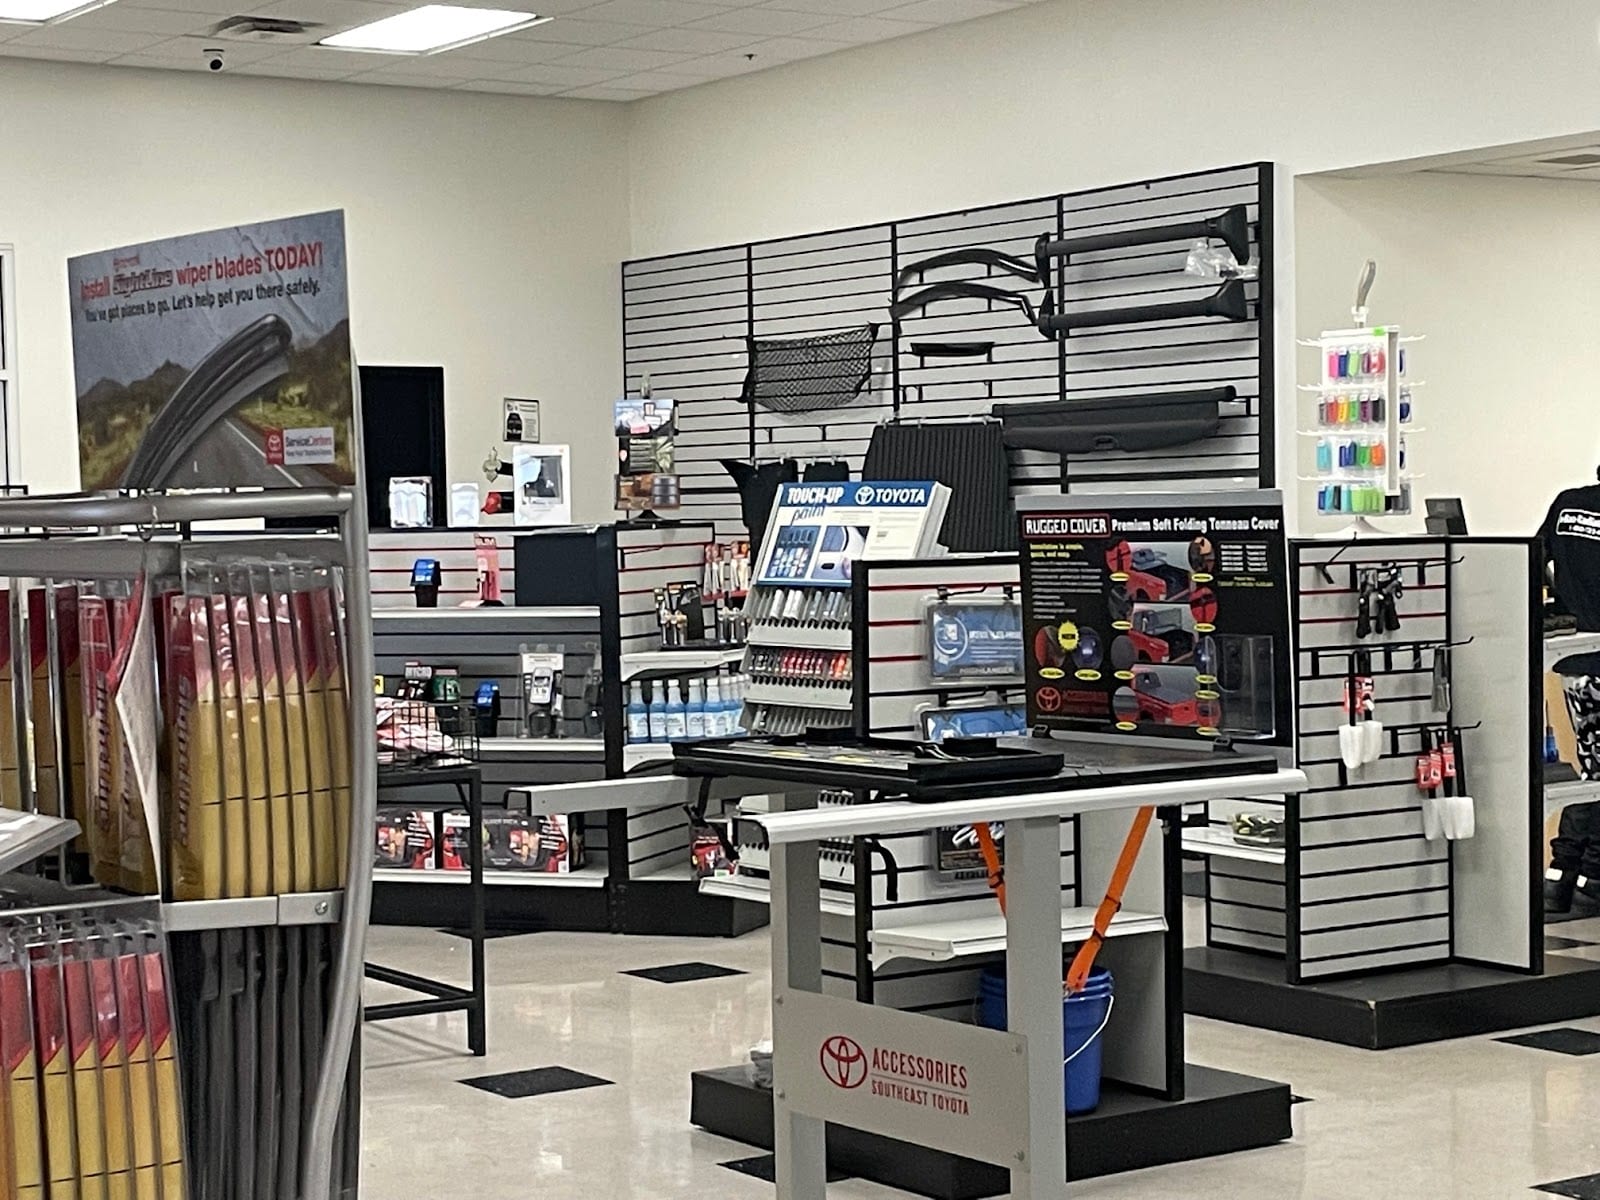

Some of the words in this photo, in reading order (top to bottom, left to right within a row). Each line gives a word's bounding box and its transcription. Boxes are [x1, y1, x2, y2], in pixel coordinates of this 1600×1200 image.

[81, 275, 110, 300] Install
[176, 262, 213, 289] wiper
[215, 254, 262, 280] blades
[264, 240, 323, 272] TODAY!
[108, 304, 119, 323] got
[121, 304, 145, 318] places
[147, 301, 156, 314] to
[157, 300, 170, 316] go.
[172, 295, 193, 311] Let's
[194, 292, 215, 309] help
[217, 288, 233, 308] get
[235, 288, 253, 306] you
[256, 283, 283, 300] there
[285, 277, 320, 297] safely.
[787, 486, 844, 504] TOUCH-UP
[876, 488, 925, 503] TOYOTA
[791, 503, 825, 526] paint
[1025, 518, 1068, 534] RUGGED
[1070, 518, 1107, 533] COVER
[1111, 518, 1150, 532] Premium
[1152, 517, 1172, 531] Soft
[1173, 517, 1207, 533] Folding
[1208, 517, 1249, 531] Tonneau
[1251, 516, 1279, 530] Cover
[872, 1047, 969, 1089] ACCESSORIES
[871, 1080, 928, 1106] SOUTHEAST
[932, 1093, 970, 1116] TOYOTA
